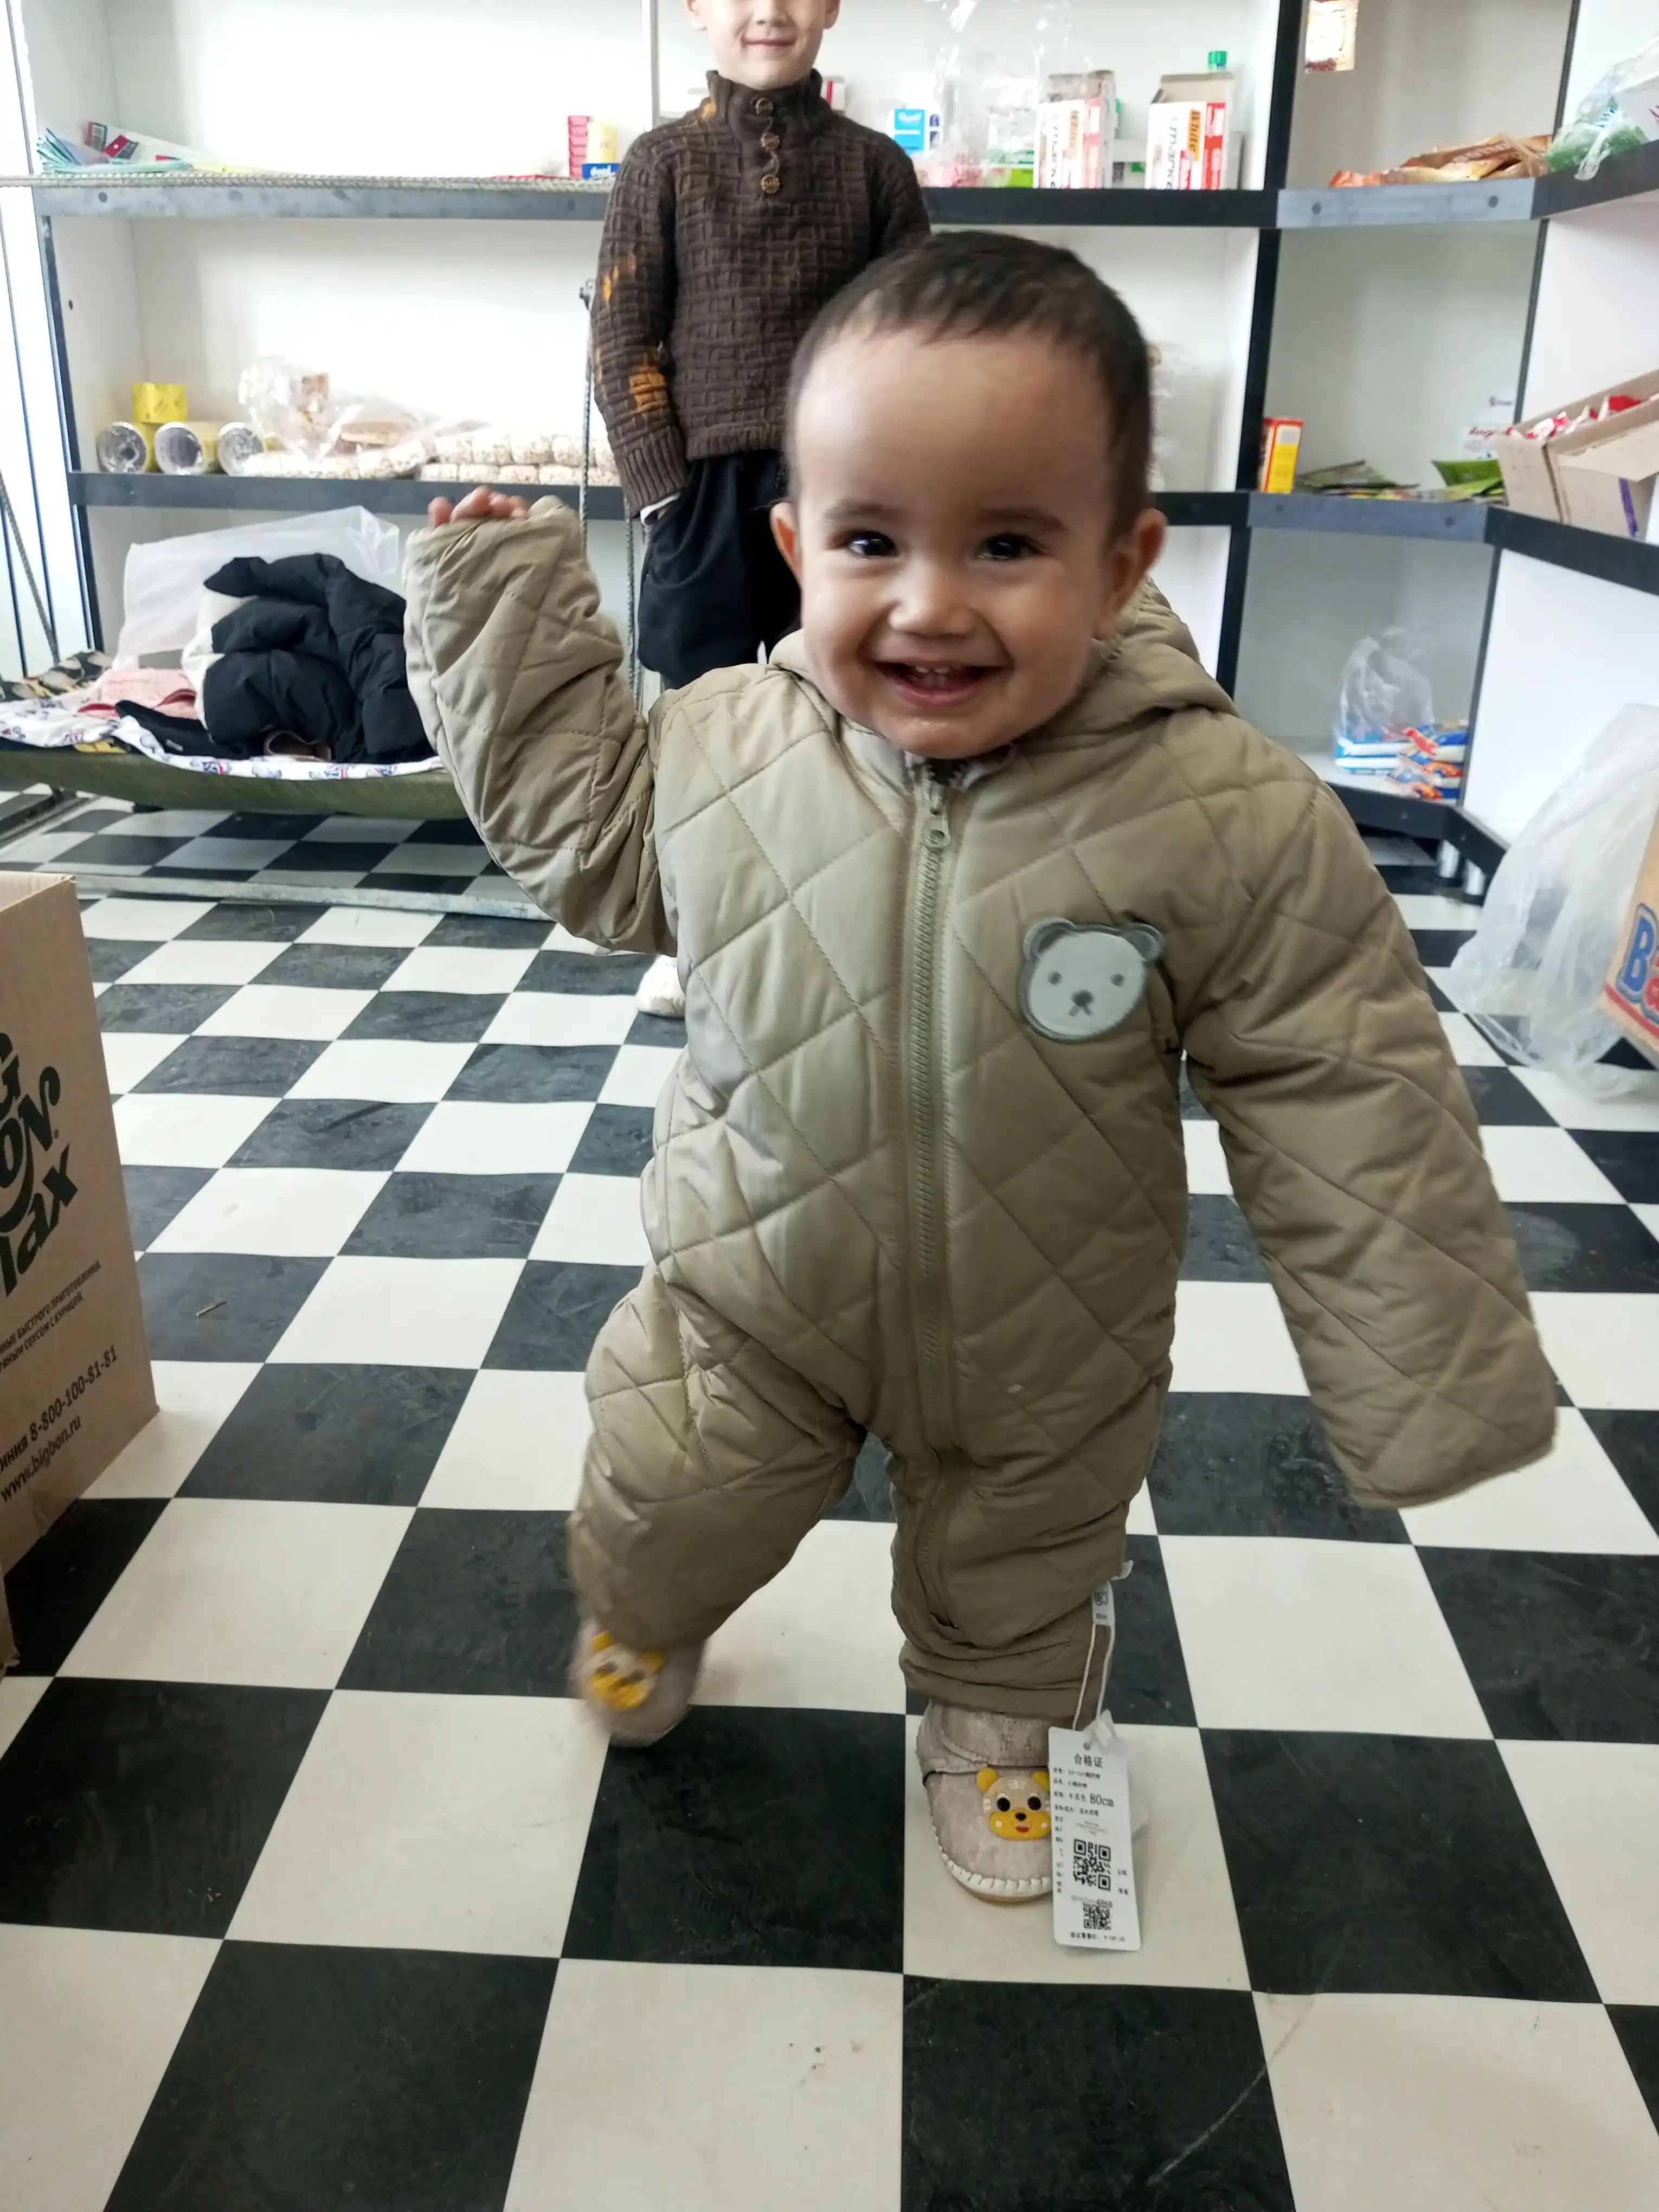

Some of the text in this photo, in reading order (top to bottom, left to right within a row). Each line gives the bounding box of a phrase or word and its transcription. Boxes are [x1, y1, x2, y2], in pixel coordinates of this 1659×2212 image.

[1189, 109, 1200, 152] White
[0, 1343, 118, 1474] ИНИЯ 8-800-100-81-81
[1, 1414, 81, 1503] www.bigbon.ru
[1073, 1753, 1103, 1769] 合格证
